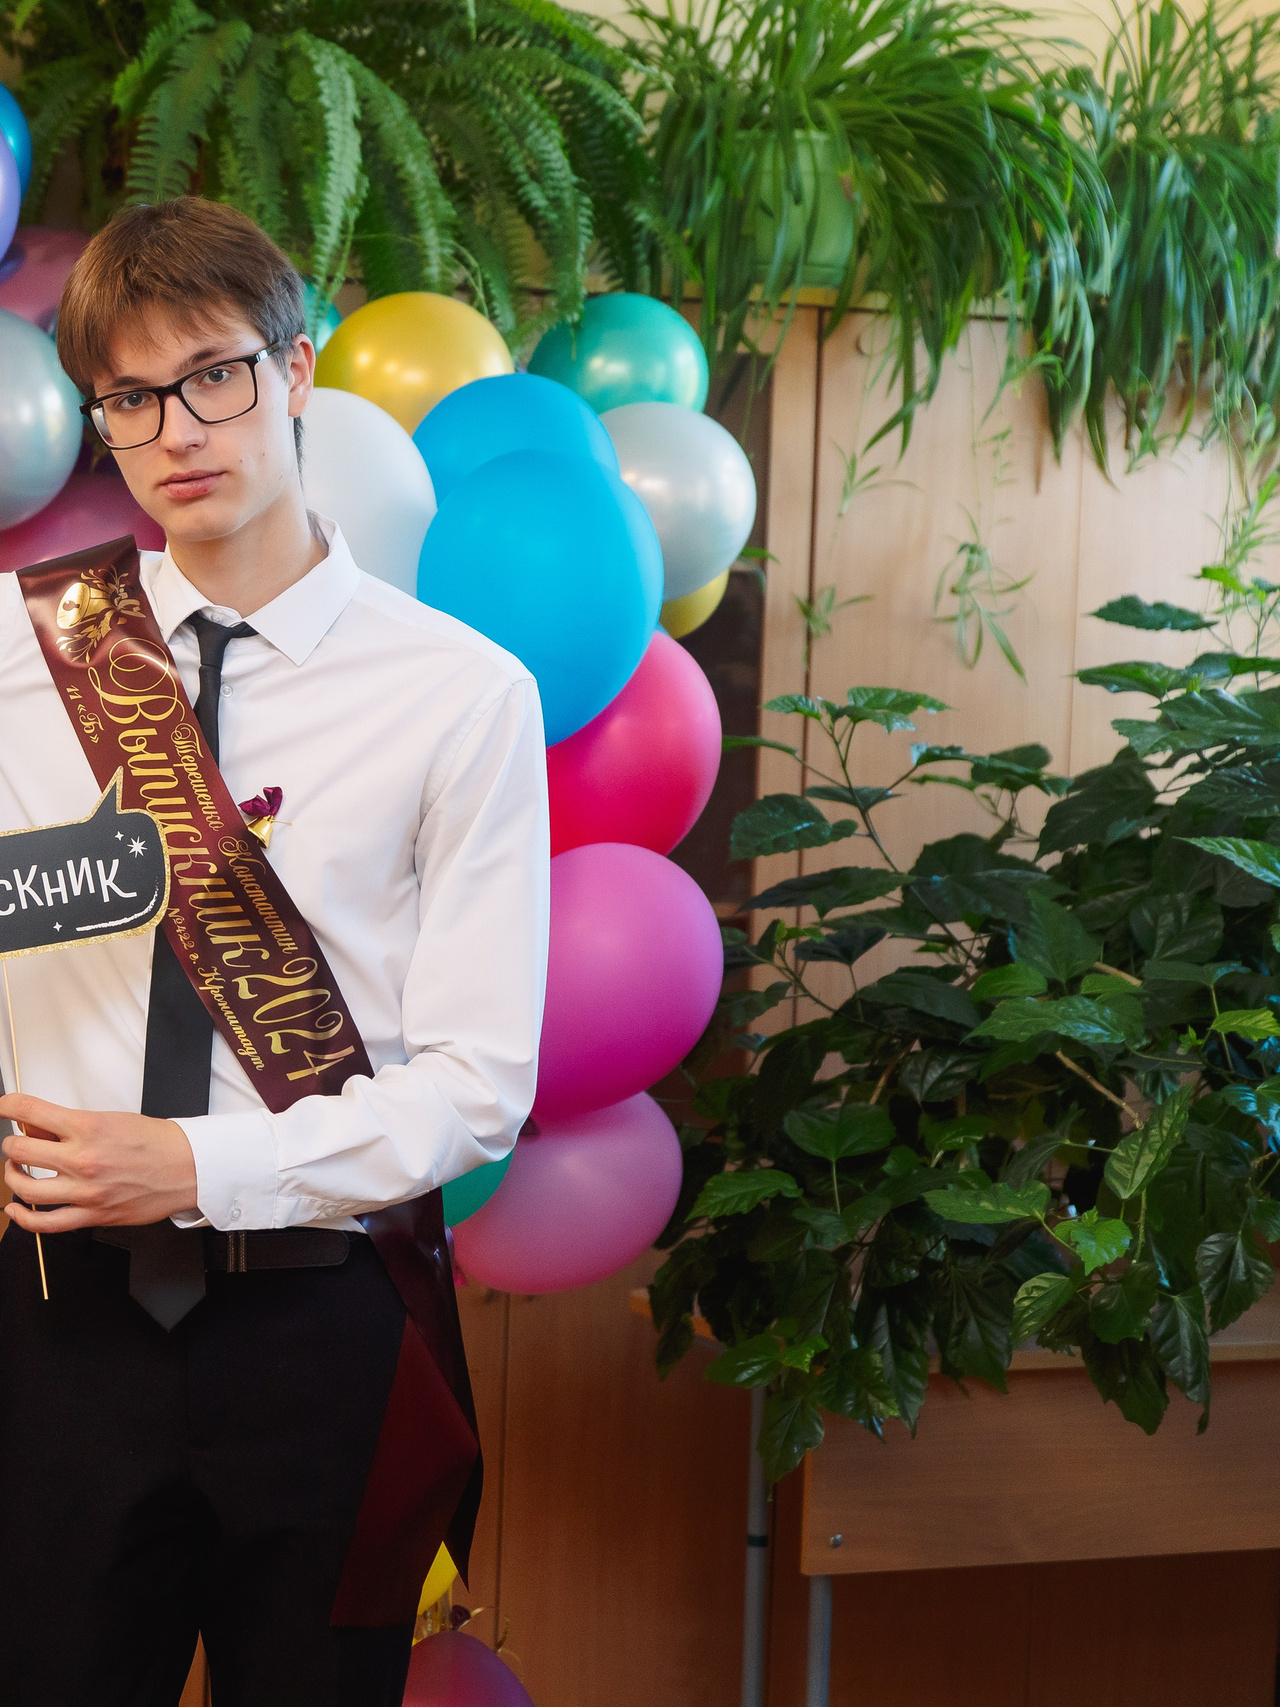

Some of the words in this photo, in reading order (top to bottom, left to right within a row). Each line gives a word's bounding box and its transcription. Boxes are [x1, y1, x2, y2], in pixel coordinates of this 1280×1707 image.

[65, 684, 83, 701] 11
[87, 637, 271, 969] Выпускник
[231, 956, 356, 1082] 2024
[170, 722, 225, 832] Терешенко
[217, 835, 299, 955] Константин
[167, 907, 198, 951] №422
[197, 965, 266, 1072] Кронштадт
